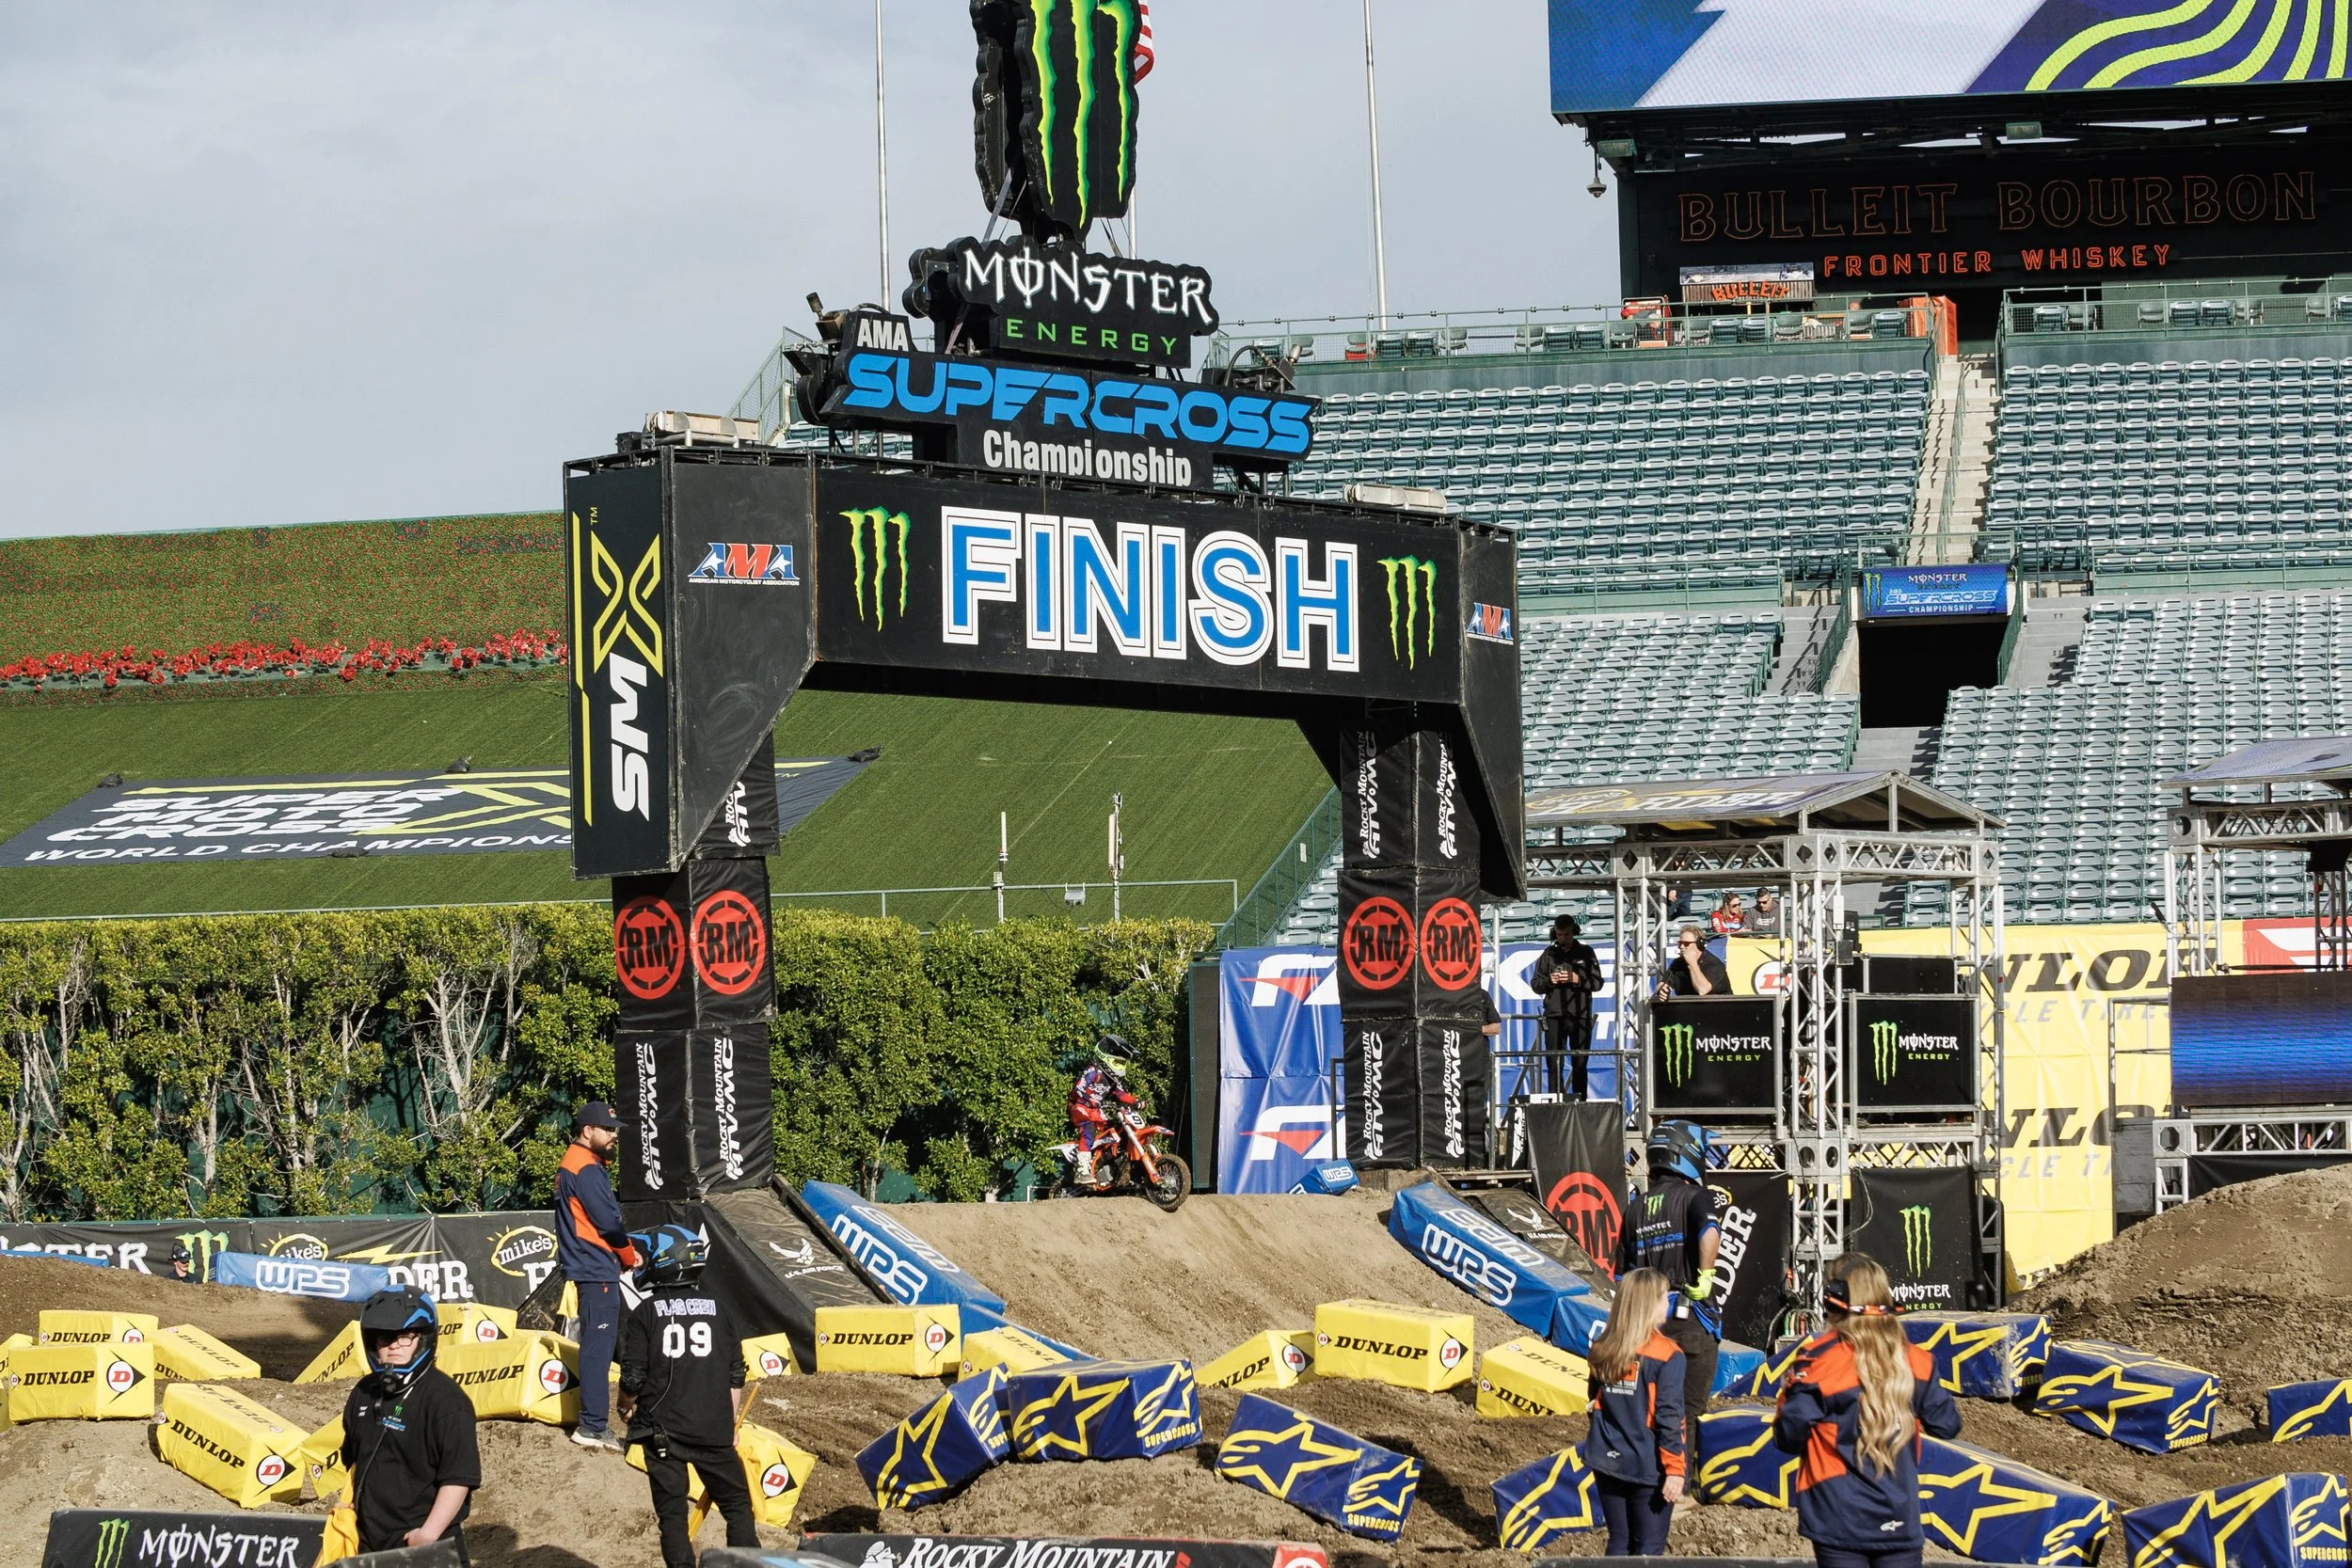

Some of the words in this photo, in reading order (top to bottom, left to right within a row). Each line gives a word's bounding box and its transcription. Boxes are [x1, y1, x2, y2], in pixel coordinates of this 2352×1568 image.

[1678, 183, 1958, 243] BULLEIT
[1998, 170, 2316, 230] BOURBON
[1822, 250, 1993, 278] FRONTIER
[2021, 244, 2171, 273] WHISKEY
[963, 246, 1213, 325] MONSTER
[1711, 279, 1790, 302] BULLEIT
[856, 317, 909, 352] AMA
[1007, 317, 1178, 356] ENERGY
[843, 353, 1315, 453] SUPERCROSS
[982, 429, 1192, 488] Championship
[688, 542, 801, 580] AMA
[1908, 572, 1968, 584] MONSTER
[941, 505, 1359, 673] FINISH
[1884, 590, 1997, 605] SUPERCROSS
[1467, 602, 1514, 641] AMA
[1908, 604, 1974, 613] CHAMPIONSHIP
[91, 787, 465, 812] SUPER
[92, 802, 423, 827] MOTO
[725, 792, 736, 826] ROC
[1438, 797, 1447, 837] ROCKY
[47, 816, 411, 841] CROSS
[1359, 799, 1370, 838] ROCKY
[24, 845, 229, 862] WORLD
[241, 834, 571, 853] CHAMPIONS
[626, 925, 672, 969] RM
[707, 920, 752, 964] RM
[1356, 924, 1404, 962] RM
[1433, 924, 1471, 962] RM
[1695, 1034, 1772, 1053] MONSTER
[1708, 1053, 1762, 1062] ENERGY
[1899, 1033, 1960, 1051] MONSTER
[636, 1042, 648, 1119] MOUNTAIN
[714, 1037, 725, 1115] MOUNTAIN
[1362, 1031, 1373, 1098] MOUNTAIN
[1443, 1029, 1452, 1097] MOUNTAIN
[1364, 1100, 1373, 1140] ROCKY
[1444, 1098, 1453, 1137] ROCKY
[641, 1120, 651, 1167] ROCKY
[718, 1115, 729, 1162] ROCKY
[1322, 1165, 1354, 1182] WPS
[499, 1236, 555, 1265] mike's
[831, 1213, 929, 1307] WPS
[1422, 1223, 1518, 1307] WPS
[256, 1257, 351, 1298] WPS
[654, 1298, 686, 1317] FLAG
[687, 1299, 717, 1316] CREW
[1905, 1302, 1943, 1311] NERGY
[51, 1332, 111, 1343] DUNLOP
[661, 1321, 713, 1359] 09
[832, 1332, 914, 1345] DUNLOP
[1333, 1335, 1428, 1361] DUNLOP
[24, 1370, 95, 1386] DUNLOP
[452, 1364, 525, 1386] DUNLOP
[1212, 1355, 1270, 1388] NLOP
[170, 1418, 246, 1469] DUNLOP
[1144, 1422, 1197, 1448] SUPERCROSS
[2169, 1433, 2208, 1449] SUPERCROSS
[1347, 1513, 1402, 1533] SUPERCROSS
[139, 1522, 300, 1568] MONSTER
[898, 1537, 1006, 1568] ROCKY
[1010, 1540, 1175, 1568] MOUNTAIN
